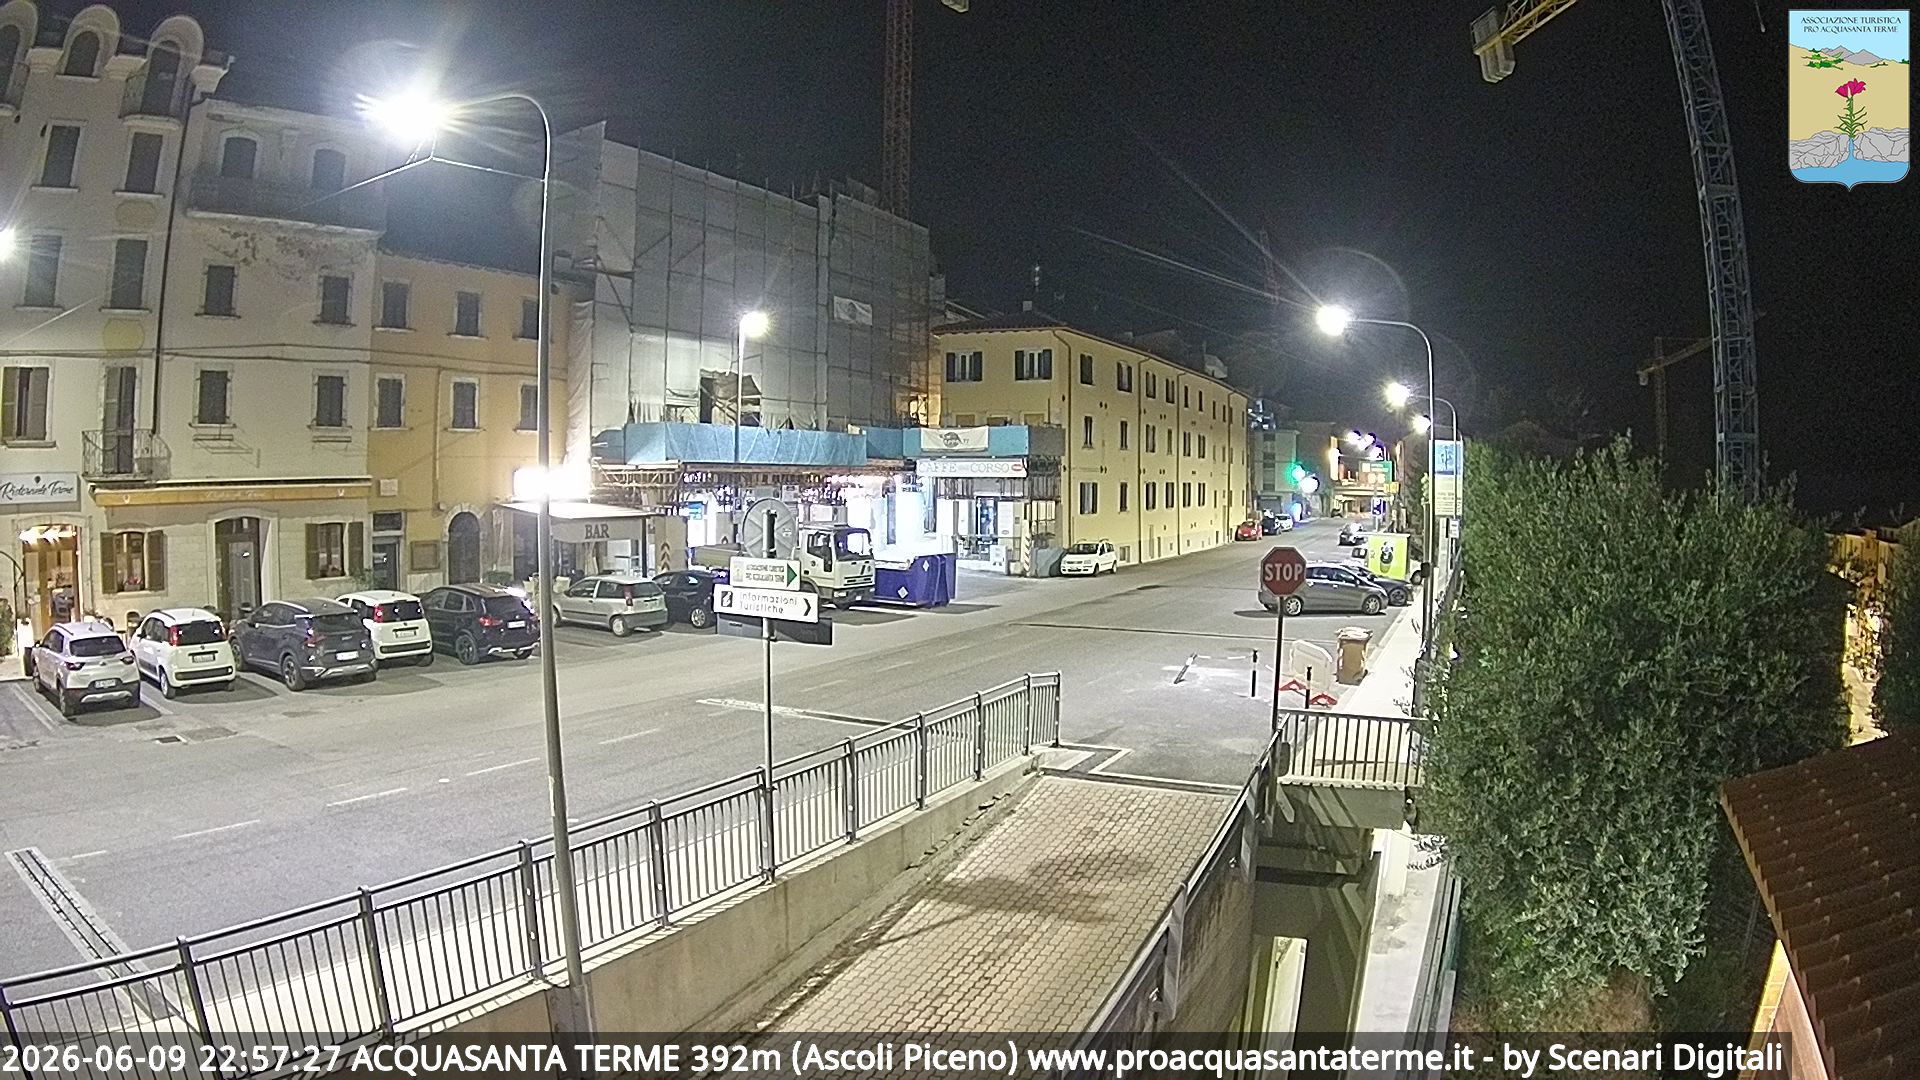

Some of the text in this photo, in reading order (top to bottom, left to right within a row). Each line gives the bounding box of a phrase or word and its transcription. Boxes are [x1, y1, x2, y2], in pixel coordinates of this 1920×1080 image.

[970, 462, 1010, 474] CORSO
[585, 523, 610, 540] BAR
[1264, 563, 1303, 582] STOP
[739, 591, 798, 606] Informazioni
[740, 601, 784, 614] Turistiche
